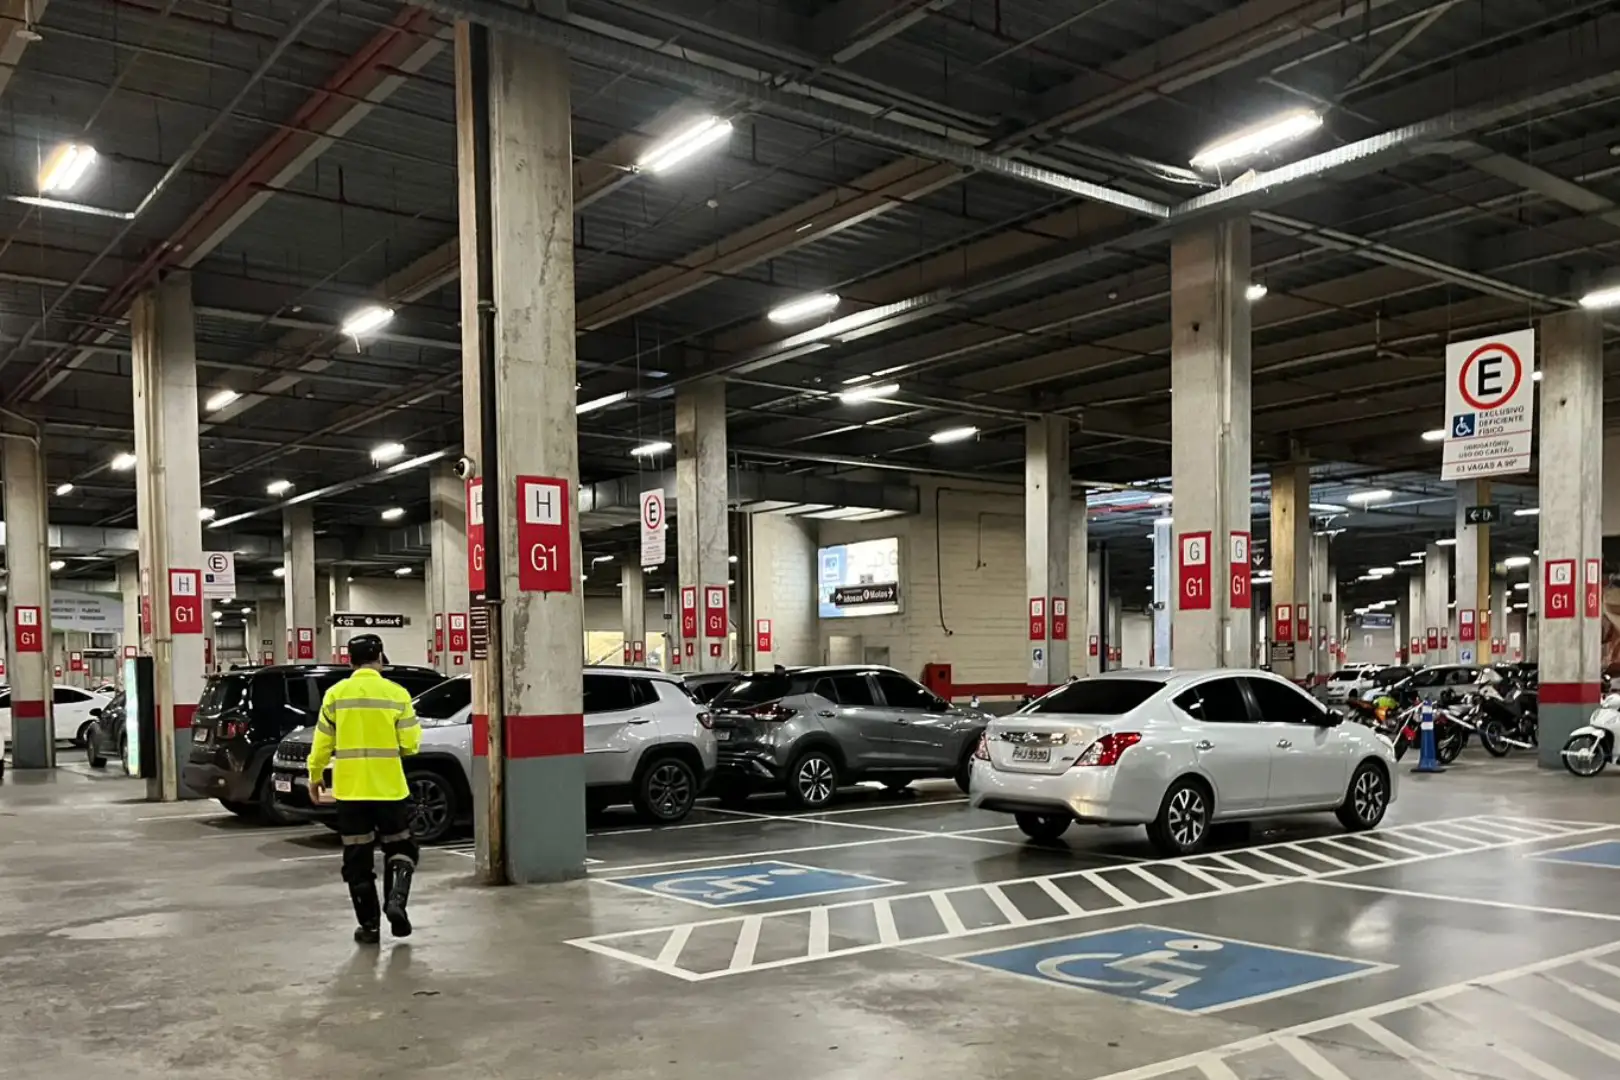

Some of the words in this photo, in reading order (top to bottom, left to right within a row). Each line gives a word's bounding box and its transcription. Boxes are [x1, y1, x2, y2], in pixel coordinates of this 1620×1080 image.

[1477, 355, 1503, 397] E
[1478, 405, 1525, 419] EXCLUSIVO
[1478, 415, 1525, 428] DEFICIENTE
[1467, 461, 1498, 473] VAGAS
[536, 490, 552, 519] H
[649, 501, 657, 522] E
[530, 543, 557, 572] G1
[1189, 541, 1201, 561] G
[1235, 539, 1243, 560] G
[212, 556, 223, 570] E
[1555, 566, 1566, 582] G
[178, 575, 190, 593] H
[1185, 577, 1203, 597] G1
[1232, 575, 1246, 595] G1
[711, 592, 721, 606] G
[1551, 593, 1568, 609] G1
[22, 612, 33, 623] H
[175, 606, 194, 623] G1
[710, 616, 722, 629] G1
[21, 632, 36, 645] G1
